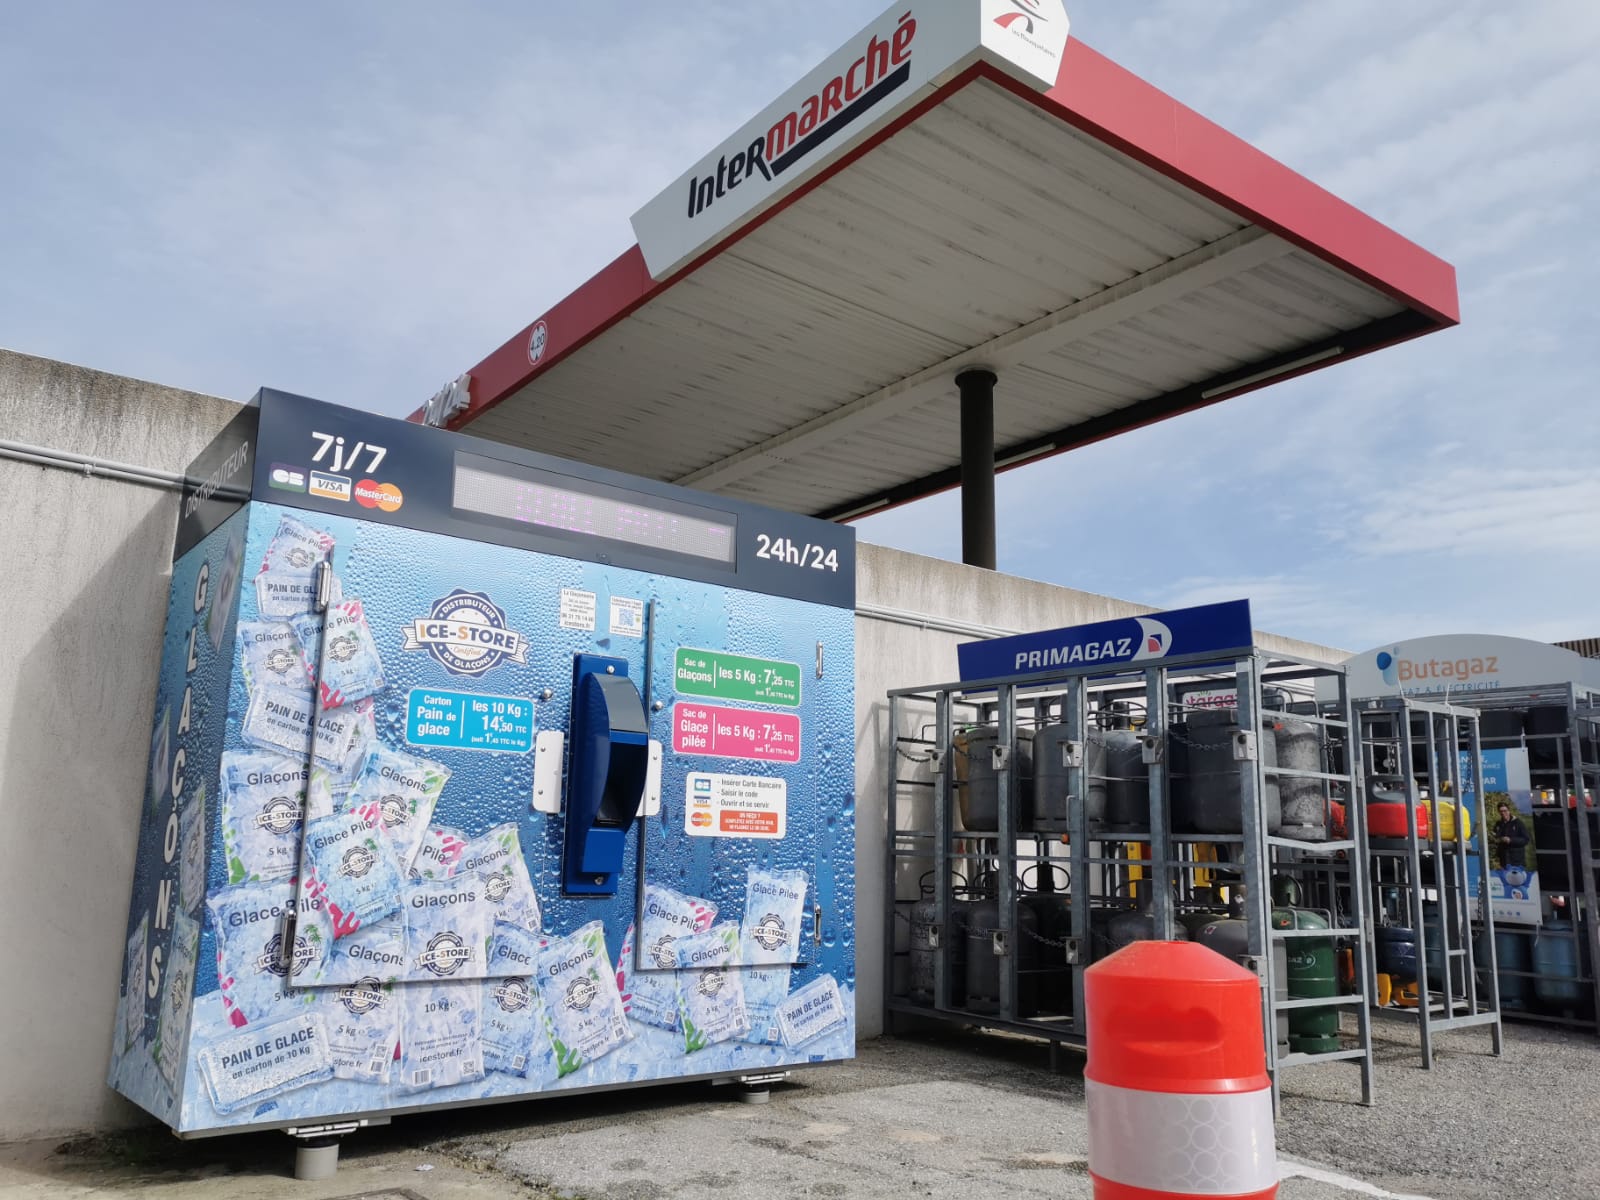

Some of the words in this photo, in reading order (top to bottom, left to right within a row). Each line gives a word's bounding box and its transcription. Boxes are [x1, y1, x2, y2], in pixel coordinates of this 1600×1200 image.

[312, 431, 387, 473] 7j/7
[184, 441, 249, 519] DISTRIBUTEUR
[317, 479, 343, 493] VISA
[355, 487, 401, 505] MasterCard
[756, 533, 839, 573] 24h/24
[267, 583, 288, 593] PAIN
[290, 584, 301, 593] DE
[442, 598, 495, 619] DISTRIBUTEUR
[420, 624, 515, 649] ICE-STORE
[443, 652, 453, 662] DE
[454, 655, 491, 669] GLAÇONS
[684, 658, 696, 667] Sac
[697, 660, 706, 668] de
[1015, 638, 1131, 670] PRIMAGAZ
[677, 668, 713, 683] Glaçons
[719, 667, 733, 679] les
[735, 669, 742, 677] 5
[744, 670, 756, 684] Kg
[784, 680, 795, 688] TTC
[1398, 656, 1498, 681] Butagaz
[424, 695, 452, 706] Carton
[472, 700, 488, 712] les
[492, 702, 505, 714] 10
[507, 703, 521, 718] Kg
[265, 701, 290, 719] PAIN
[292, 709, 307, 723] DE
[308, 715, 345, 735] GLACE
[417, 706, 443, 720] Pain
[446, 711, 456, 721] de
[683, 709, 696, 718] Sac
[698, 711, 707, 719] de
[418, 722, 450, 737] glace
[515, 725, 527, 733] TTC
[681, 720, 709, 734] Glace
[718, 723, 732, 736] les
[734, 725, 740, 736] 5
[743, 726, 755, 740] Kg
[784, 734, 794, 742] TTC
[682, 735, 707, 749] pilée
[247, 770, 308, 785] Glaçons
[381, 766, 428, 792] Glaçons
[742, 780, 757, 788] Carte
[721, 799, 738, 807] Ouvrir
[314, 829, 348, 849] Glace
[465, 848, 509, 870] Glaçons
[752, 883, 777, 895] Glace
[411, 891, 476, 909] Glaçons
[229, 905, 280, 927] Glace
[650, 903, 679, 925] Glace
[350, 944, 404, 966] Glaçons
[421, 948, 470, 962] ICE-STORE
[549, 948, 595, 976] Glaçons
[692, 945, 729, 963] Glaçons
[274, 991, 281, 1001] 5
[283, 988, 295, 1000] kg
[341, 990, 383, 1001] ICE-STORE
[496, 987, 529, 1003] ICE-STORE
[425, 1003, 436, 1013] 10
[786, 1007, 803, 1022] PAIN
[804, 1002, 812, 1013] DE
[813, 990, 834, 1006] GLACE
[338, 1025, 344, 1034] 5
[345, 1026, 356, 1037] kg
[222, 1049, 252, 1069] PAIN
[256, 1042, 272, 1058] DE
[275, 1027, 315, 1051] GLACE
[419, 1048, 463, 1063] icestore.fr
[232, 1070, 244, 1080] en
[245, 1060, 273, 1075] carton
[274, 1054, 285, 1065] de
[288, 1051, 298, 1061] 10
[299, 1046, 311, 1059] Kg
